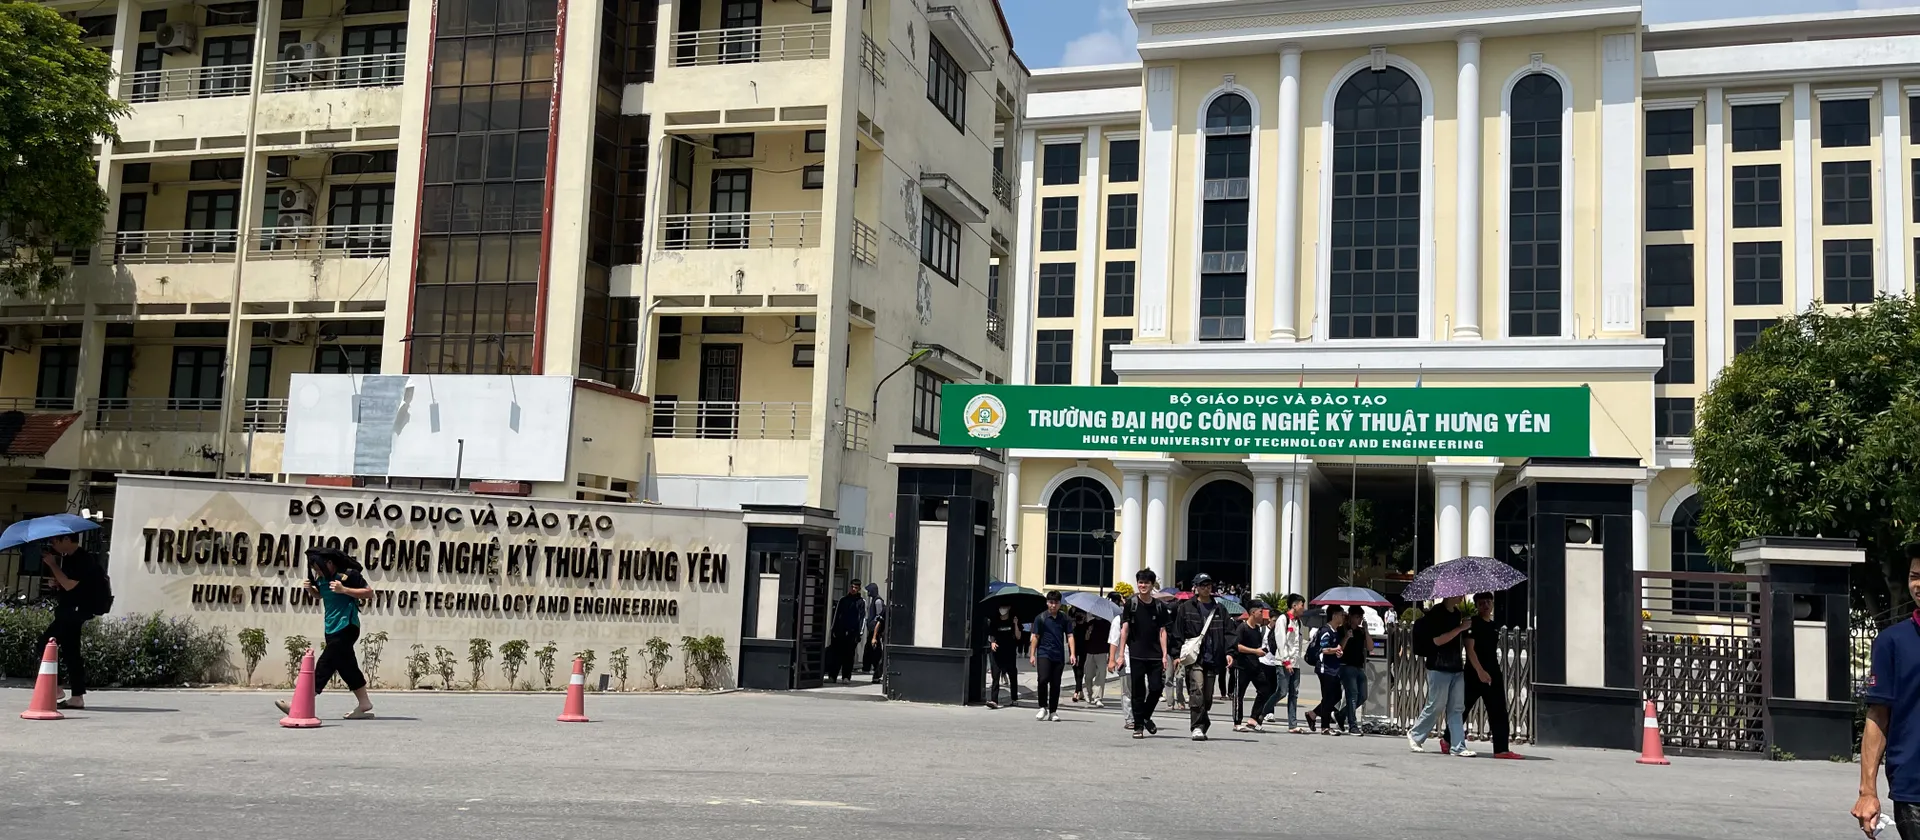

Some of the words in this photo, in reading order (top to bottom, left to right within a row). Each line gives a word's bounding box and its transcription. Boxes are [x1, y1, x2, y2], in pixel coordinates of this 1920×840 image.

[1170, 393, 1192, 407] BỘ
[1196, 393, 1239, 405] GIÁO
[1243, 395, 1279, 407] DỤC
[1283, 393, 1306, 405] VÀ
[1310, 393, 1349, 405] ĐÀO
[1353, 395, 1387, 408] TẠO
[1028, 406, 1107, 428] TRƯỜNG
[1111, 410, 1146, 432] ĐẠI
[1151, 411, 1193, 433] HỌC
[1198, 408, 1256, 431] CÔNG
[1262, 409, 1320, 435] NGHỆ
[1326, 409, 1354, 432] KỸ
[1359, 409, 1430, 436] THUẬT
[1435, 411, 1499, 432] HƯNG
[1505, 409, 1551, 433] YÊN
[1082, 435, 1118, 444] HUNG
[1122, 435, 1147, 445] YEN
[1150, 436, 1231, 447] UNIVERSITY
[1234, 437, 1251, 447] OF
[1254, 438, 1345, 448] TECHNOLOGY
[1349, 439, 1378, 449] AND
[1383, 439, 1484, 450] ENGINEERING
[288, 495, 326, 524] BỘ
[335, 496, 403, 521] GIÁO
[410, 504, 463, 530] DỤC
[470, 503, 498, 527] VÀ
[507, 505, 560, 529] ĐÀO
[567, 513, 614, 537] TẠO
[143, 519, 249, 566] TRƯỜNG
[257, 532, 301, 575] ĐẠI
[364, 530, 430, 572] CÔNG
[437, 536, 500, 583] NGHỆ
[507, 538, 538, 577] KỸ
[544, 541, 613, 587] THUẬT
[618, 547, 680, 582] HƯNG
[686, 546, 728, 583] YÊN
[191, 583, 243, 605] HUNG
[250, 585, 285, 606] YEN
[398, 590, 419, 609] OF
[536, 595, 569, 614] AND
[574, 596, 678, 617] ENGINEERING
